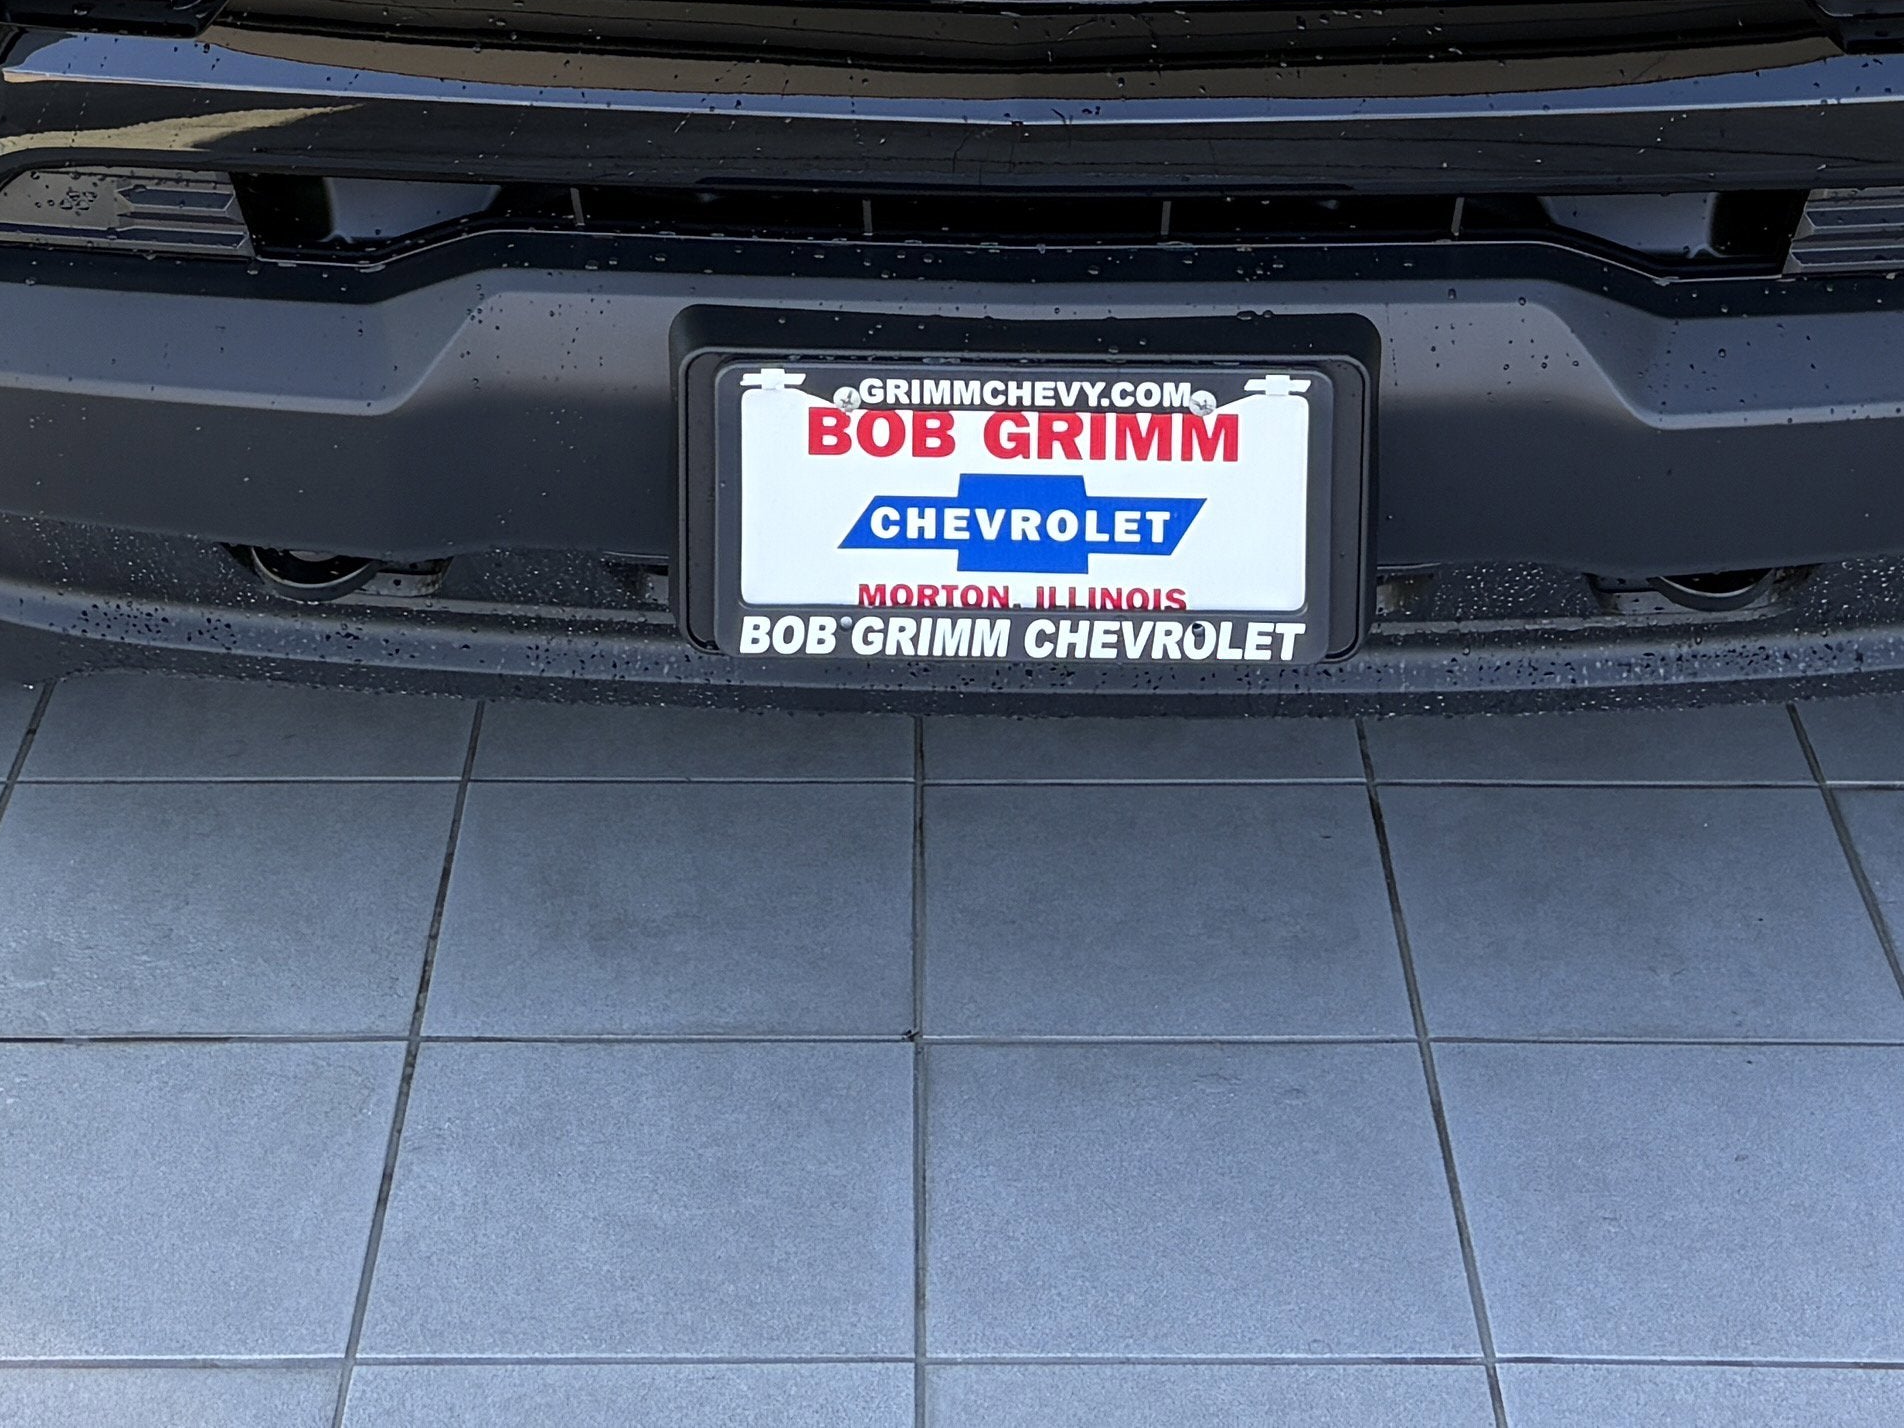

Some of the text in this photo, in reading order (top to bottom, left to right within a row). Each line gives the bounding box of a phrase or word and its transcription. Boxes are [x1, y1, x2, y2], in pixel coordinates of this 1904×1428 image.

[858, 377, 1192, 408] GRIMMCHEVY.COM
[807, 408, 1240, 463] BOB GRIMM
[869, 506, 1172, 544] CHEVROLET
[1036, 585, 1188, 611] ILLINOIS
[739, 616, 1306, 661] BOB GRIMM CHEVROLET
